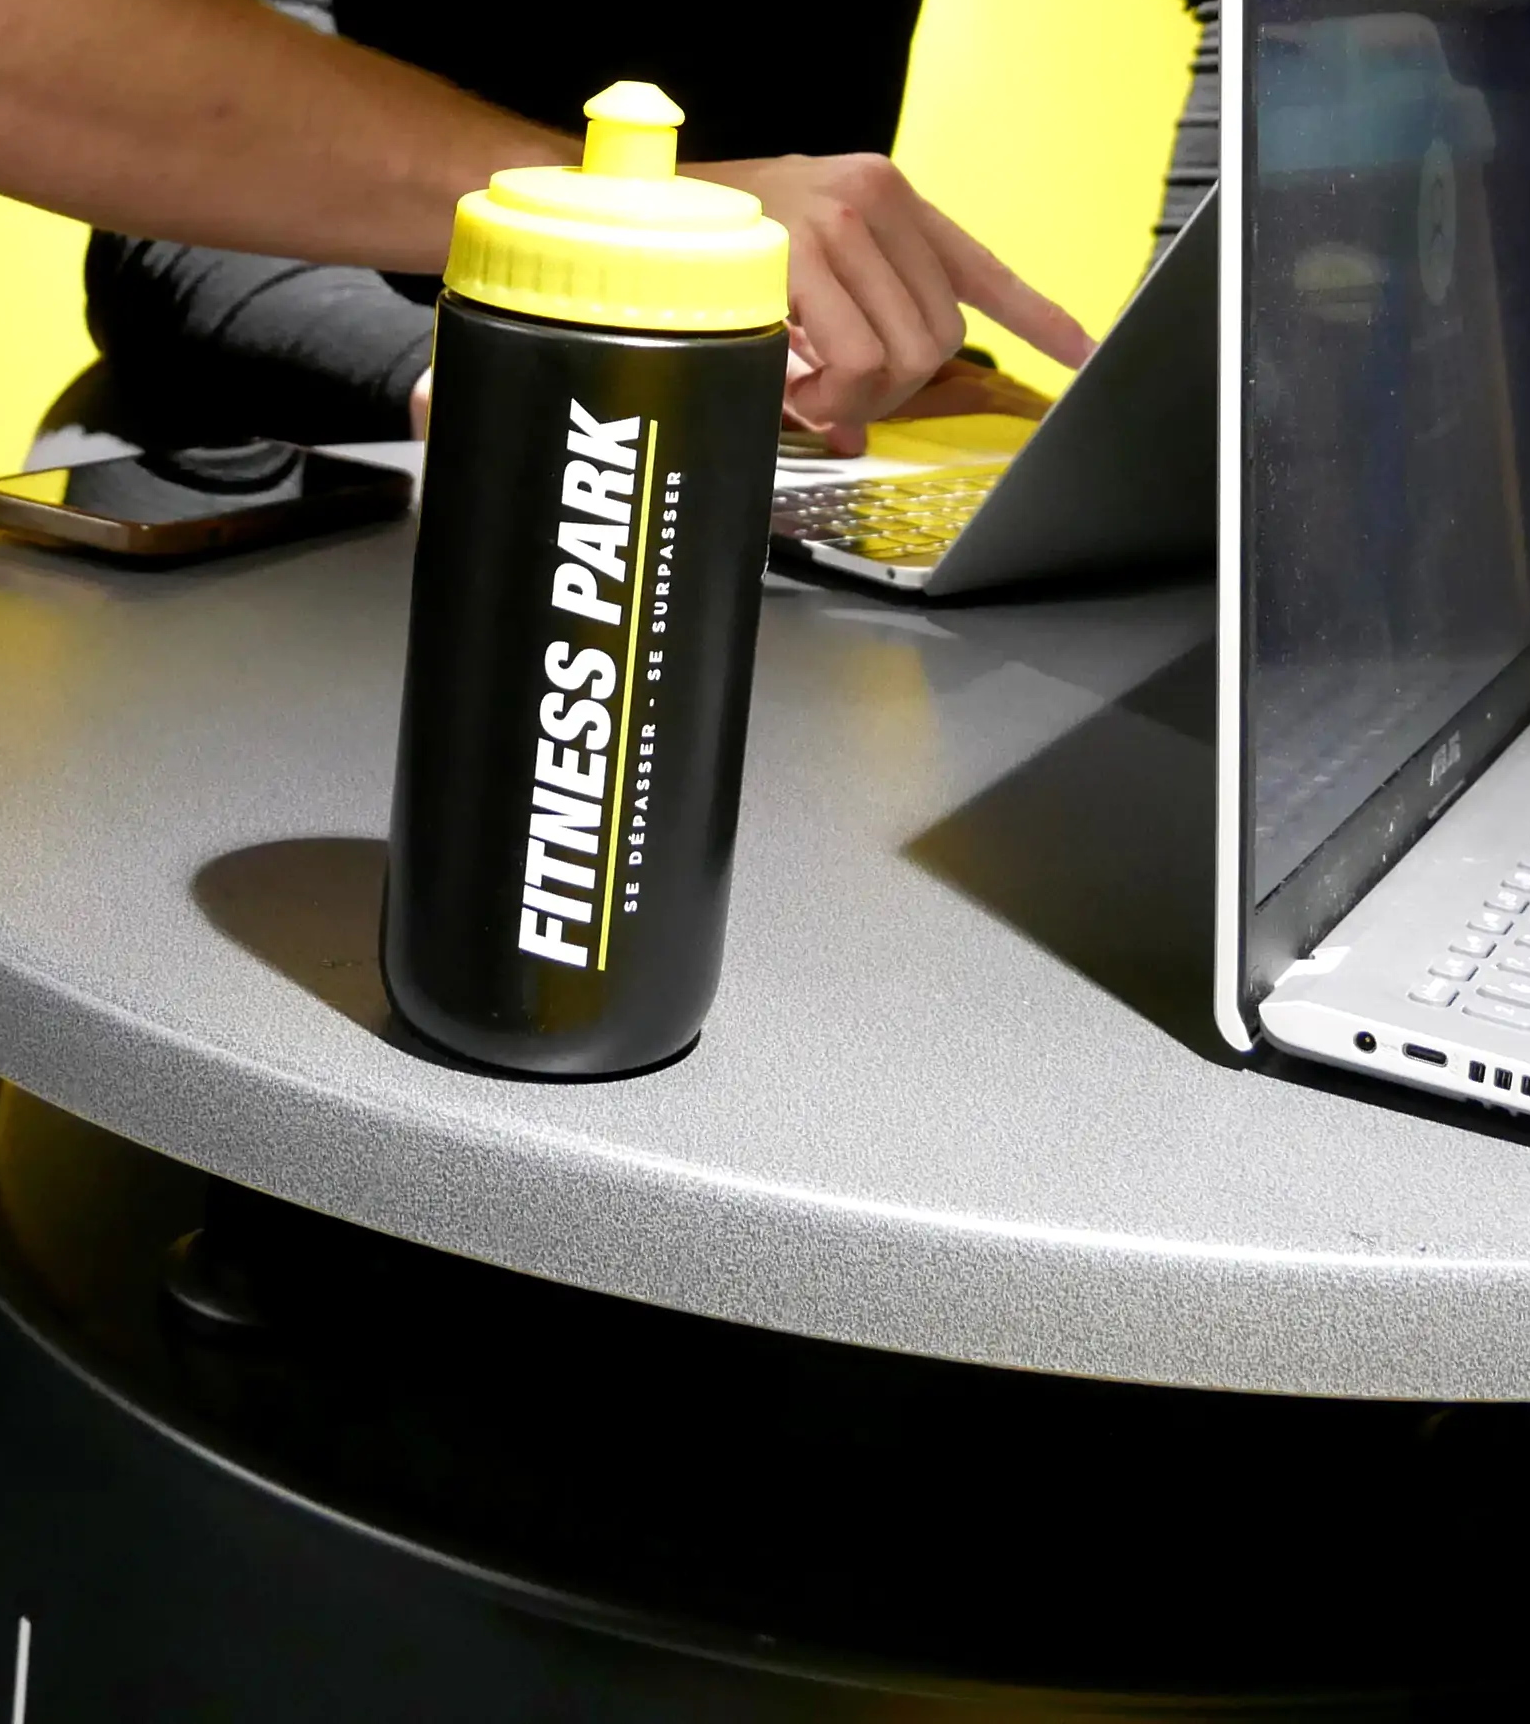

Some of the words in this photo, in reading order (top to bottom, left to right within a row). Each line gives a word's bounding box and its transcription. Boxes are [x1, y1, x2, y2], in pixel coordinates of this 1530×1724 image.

[552, 398, 640, 625] PARK
[651, 471, 682, 634] SURPASSER
[647, 650, 663, 681] SE
[519, 641, 616, 968] FITNESS
[628, 723, 656, 865] DÉPASSER
[623, 882, 639, 913] SE
